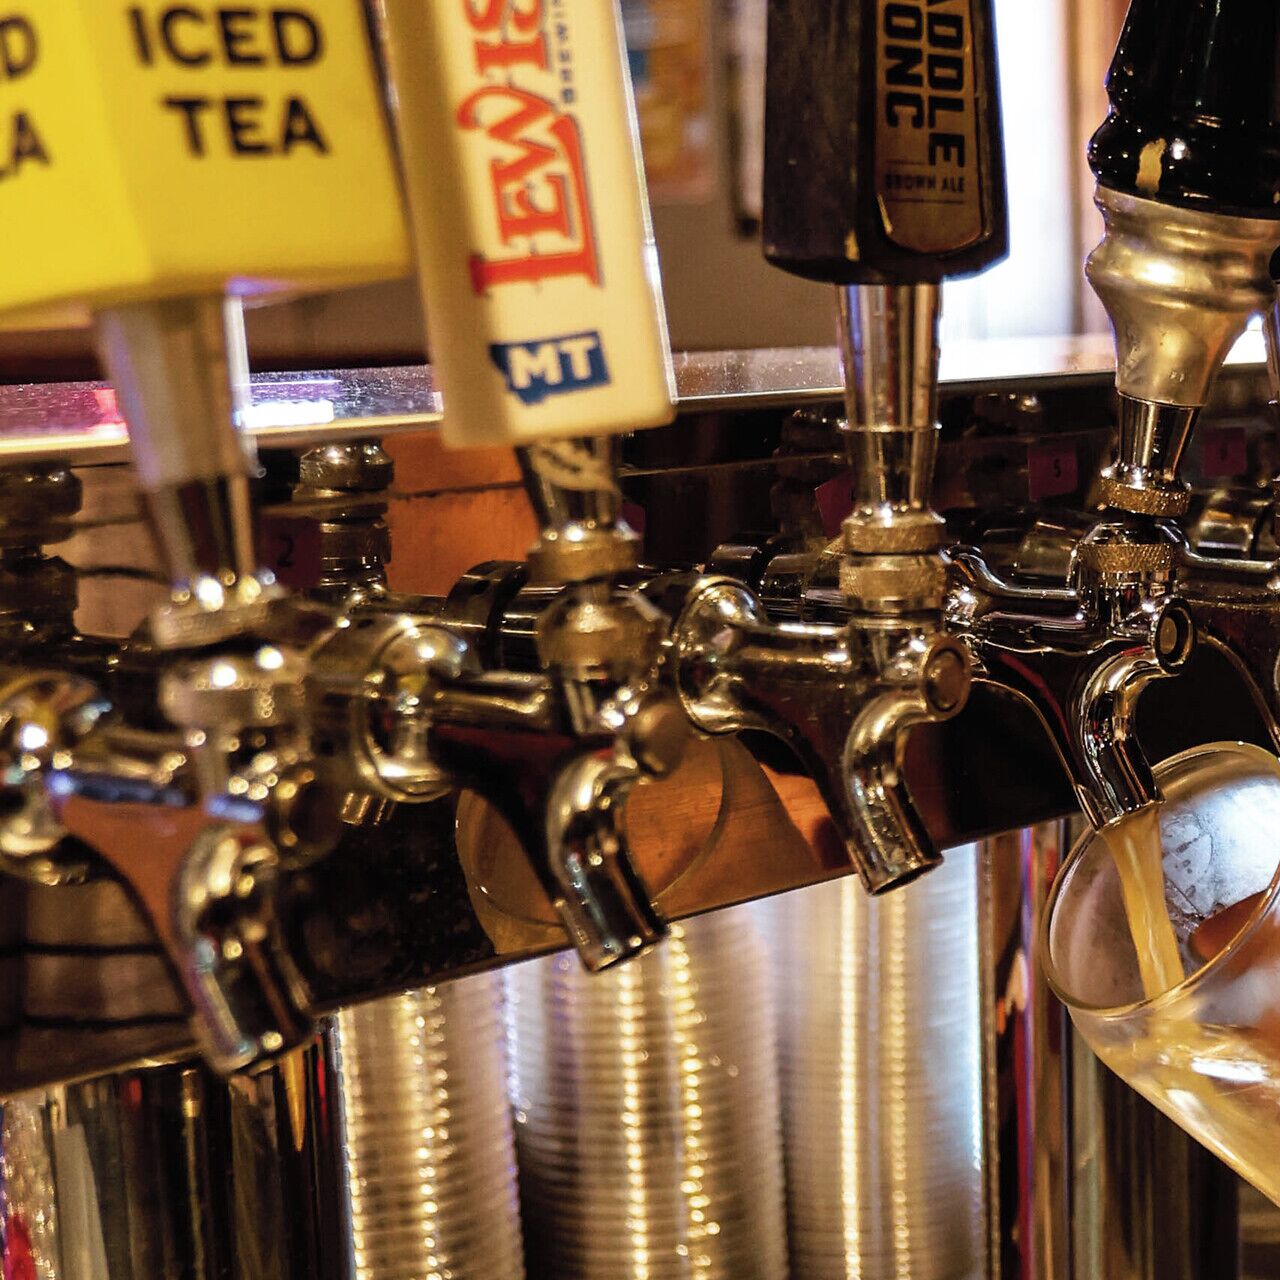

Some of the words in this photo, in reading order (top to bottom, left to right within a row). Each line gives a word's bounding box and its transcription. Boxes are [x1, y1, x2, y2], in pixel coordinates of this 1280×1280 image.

[128, 5, 325, 67] ICED
[162, 95, 330, 158] TEA
[941, 176, 965, 193] ALE
[508, 335, 598, 390] MT
[276, 532, 295, 568] 2
